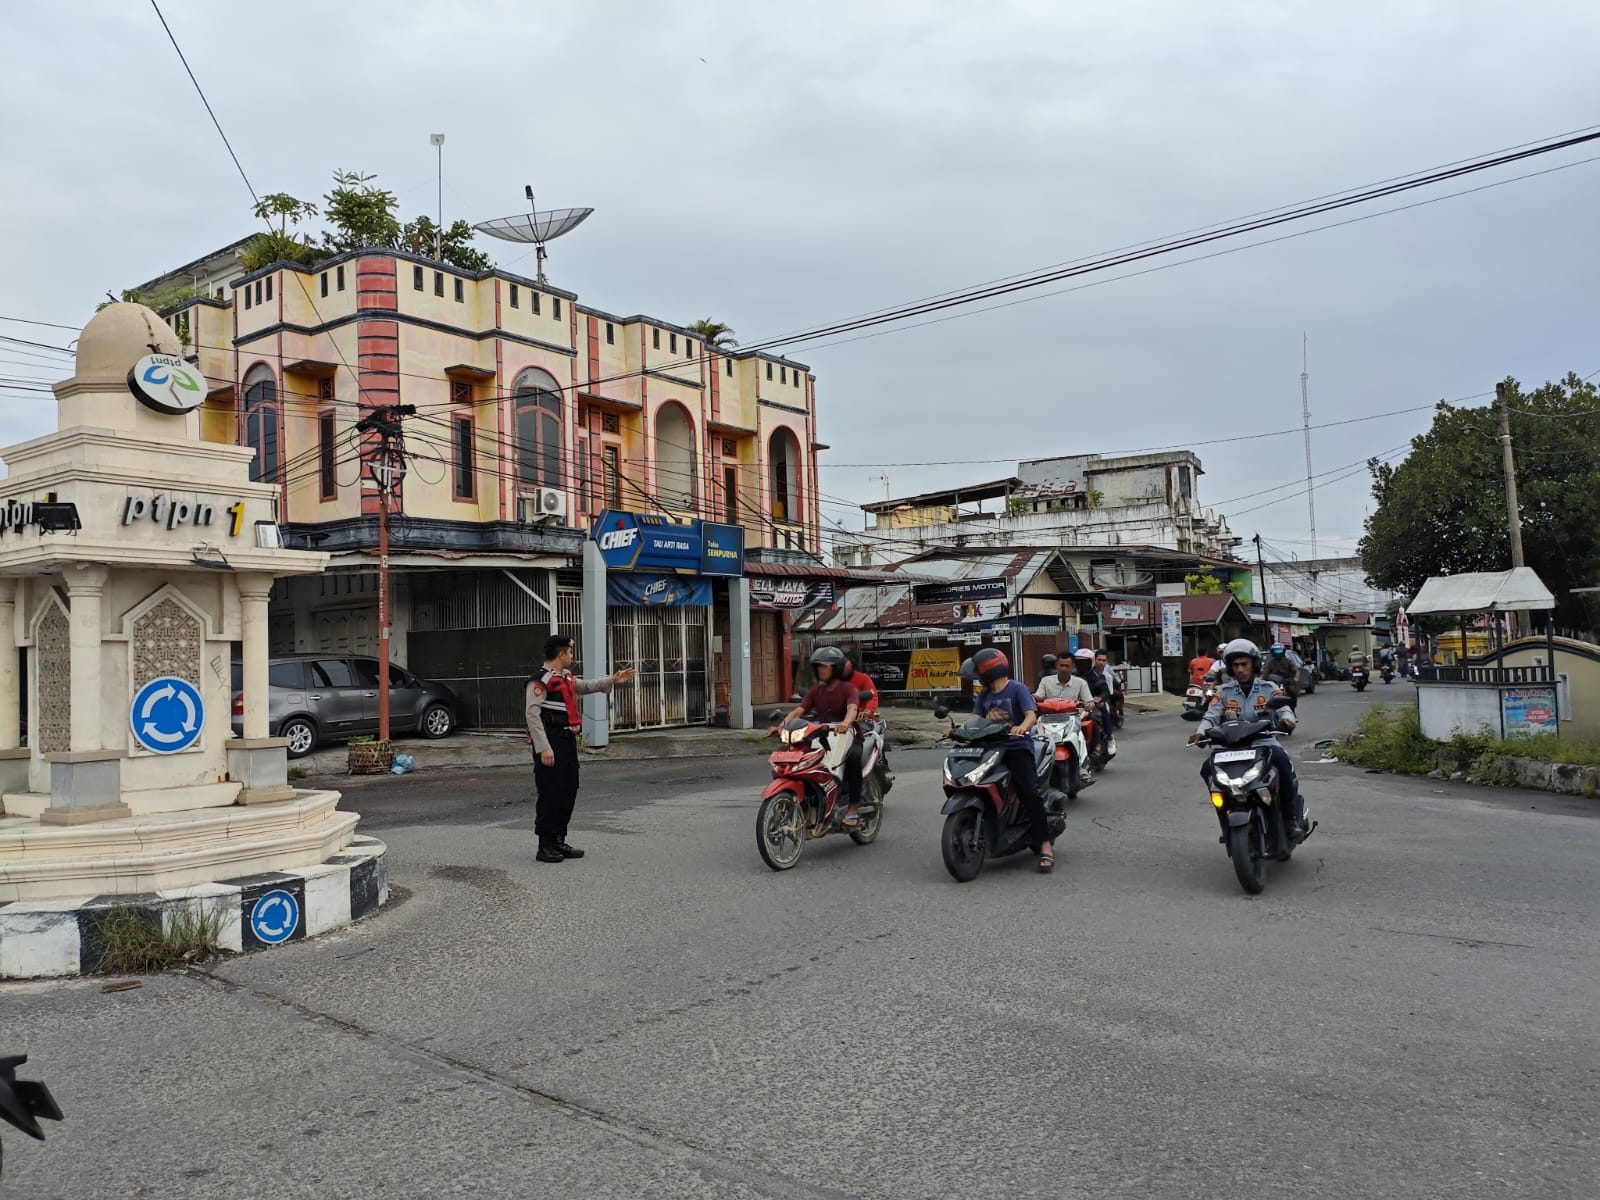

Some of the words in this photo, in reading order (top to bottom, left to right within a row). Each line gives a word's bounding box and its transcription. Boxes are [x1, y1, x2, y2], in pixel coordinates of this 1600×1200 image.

[0, 502, 33, 534] tpn
[123, 495, 215, 529] ptpn
[228, 501, 245, 536] 1
[600, 527, 639, 550] CHIEF
[707, 549, 738, 559] SEMPURNA
[645, 579, 667, 596] CHIEF
[778, 580, 806, 592] JAYA
[972, 582, 1005, 592] MOTOR
[774, 593, 805, 605] MOTOR
[953, 602, 982, 618] STIK
[912, 669, 928, 679] 3M
